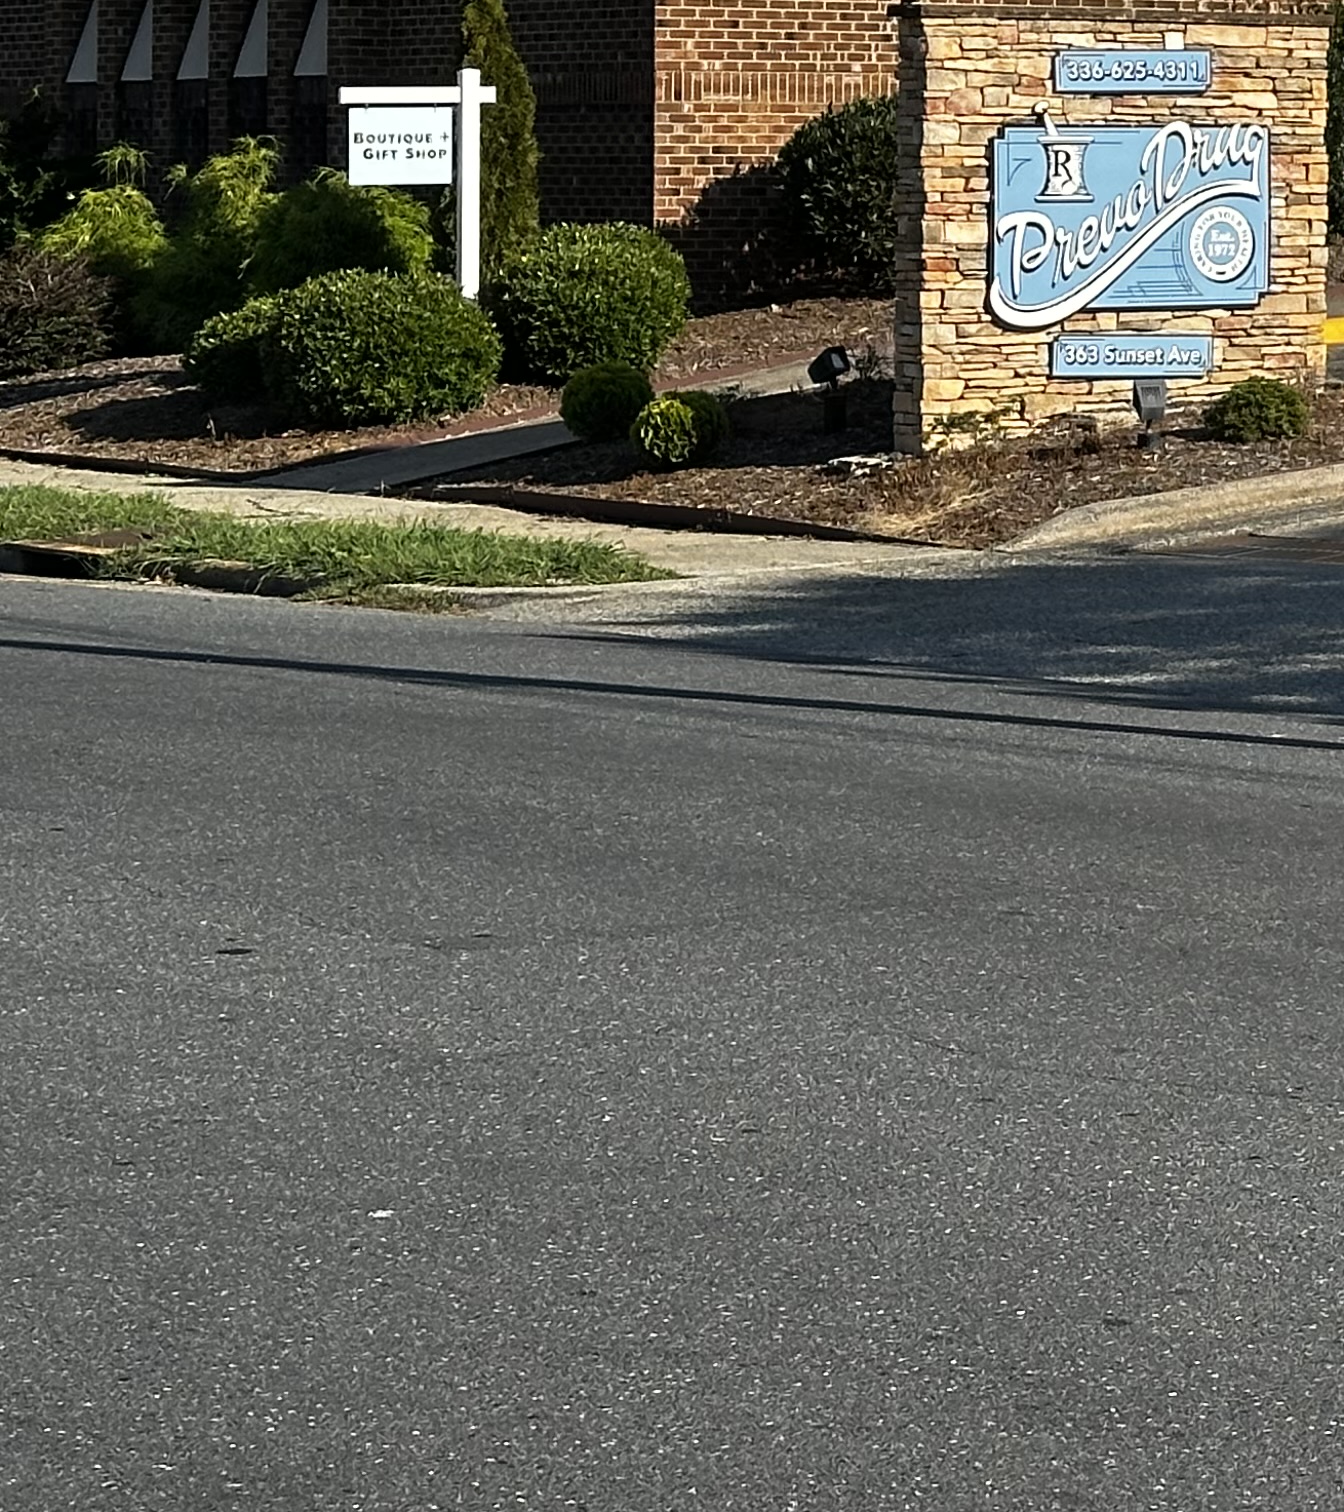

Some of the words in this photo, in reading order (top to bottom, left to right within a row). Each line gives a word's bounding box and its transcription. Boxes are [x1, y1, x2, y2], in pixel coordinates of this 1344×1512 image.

[1067, 60, 1199, 81] 336-625-4311
[353, 132, 432, 145] BOUTIQUE
[363, 148, 398, 160] GIFT
[405, 147, 447, 159] SHOP
[997, 179, 1152, 299] Prevo
[1140, 120, 1266, 214] Drug
[1208, 243, 1236, 257] 1972
[1064, 345, 1099, 365] 363
[1104, 344, 1164, 365] Sunset
[1167, 345, 1202, 365] Ave
